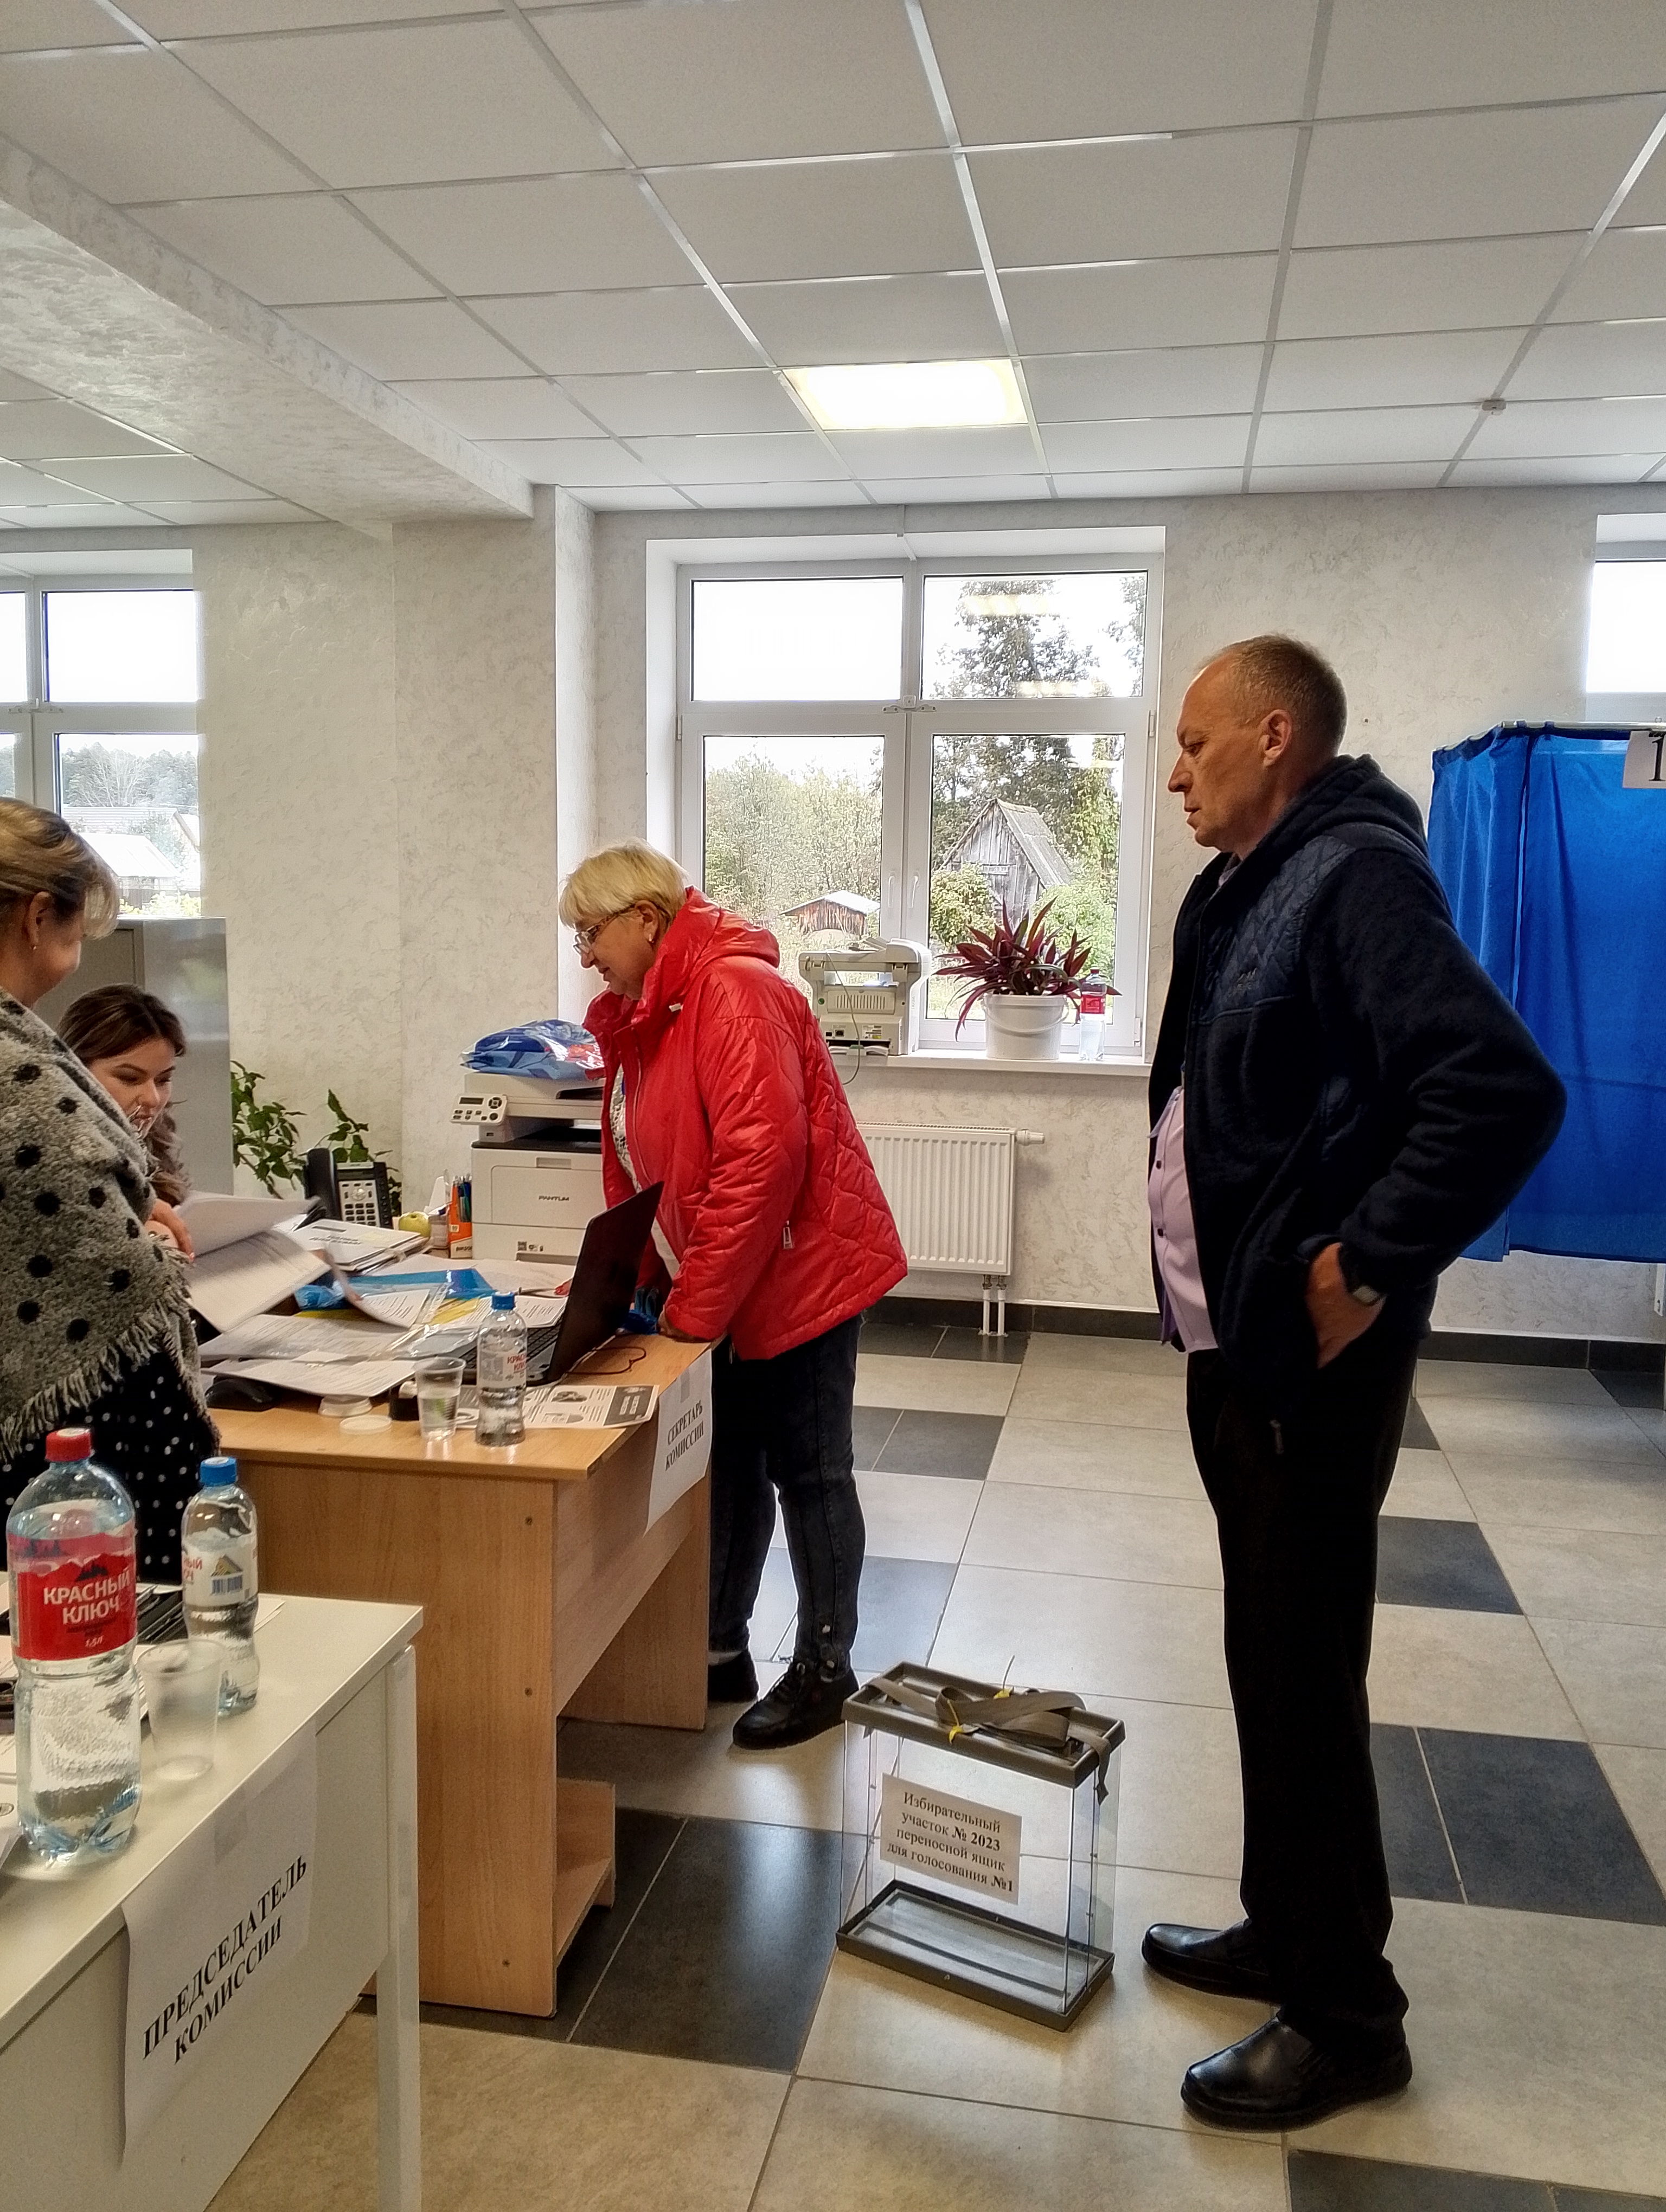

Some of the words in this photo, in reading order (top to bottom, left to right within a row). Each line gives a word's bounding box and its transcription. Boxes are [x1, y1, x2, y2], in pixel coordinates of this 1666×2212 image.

[507, 1354, 526, 1364] КРАС
[668, 1399, 703, 1445] СЕКРЕТАРЬ
[665, 1420, 704, 1471] КОМИССИИ
[43, 1567, 130, 1605] КРАСНЫЙ
[62, 1595, 120, 1624] КЛЮЧ
[902, 1812, 949, 1836] участок
[952, 1826, 967, 1842] №
[970, 1832, 1000, 1851] 2023
[904, 1791, 1000, 1833] Избирательный
[887, 1843, 907, 1858] для
[911, 1850, 987, 1884] голосования
[991, 1875, 1013, 1892] №1
[896, 1829, 967, 1859] переносной
[971, 1853, 1005, 1872] ящик
[143, 1855, 306, 2060] ПРЕДСЕДАТЕЛЬ
[175, 1915, 282, 2065] КОМИССИИ
